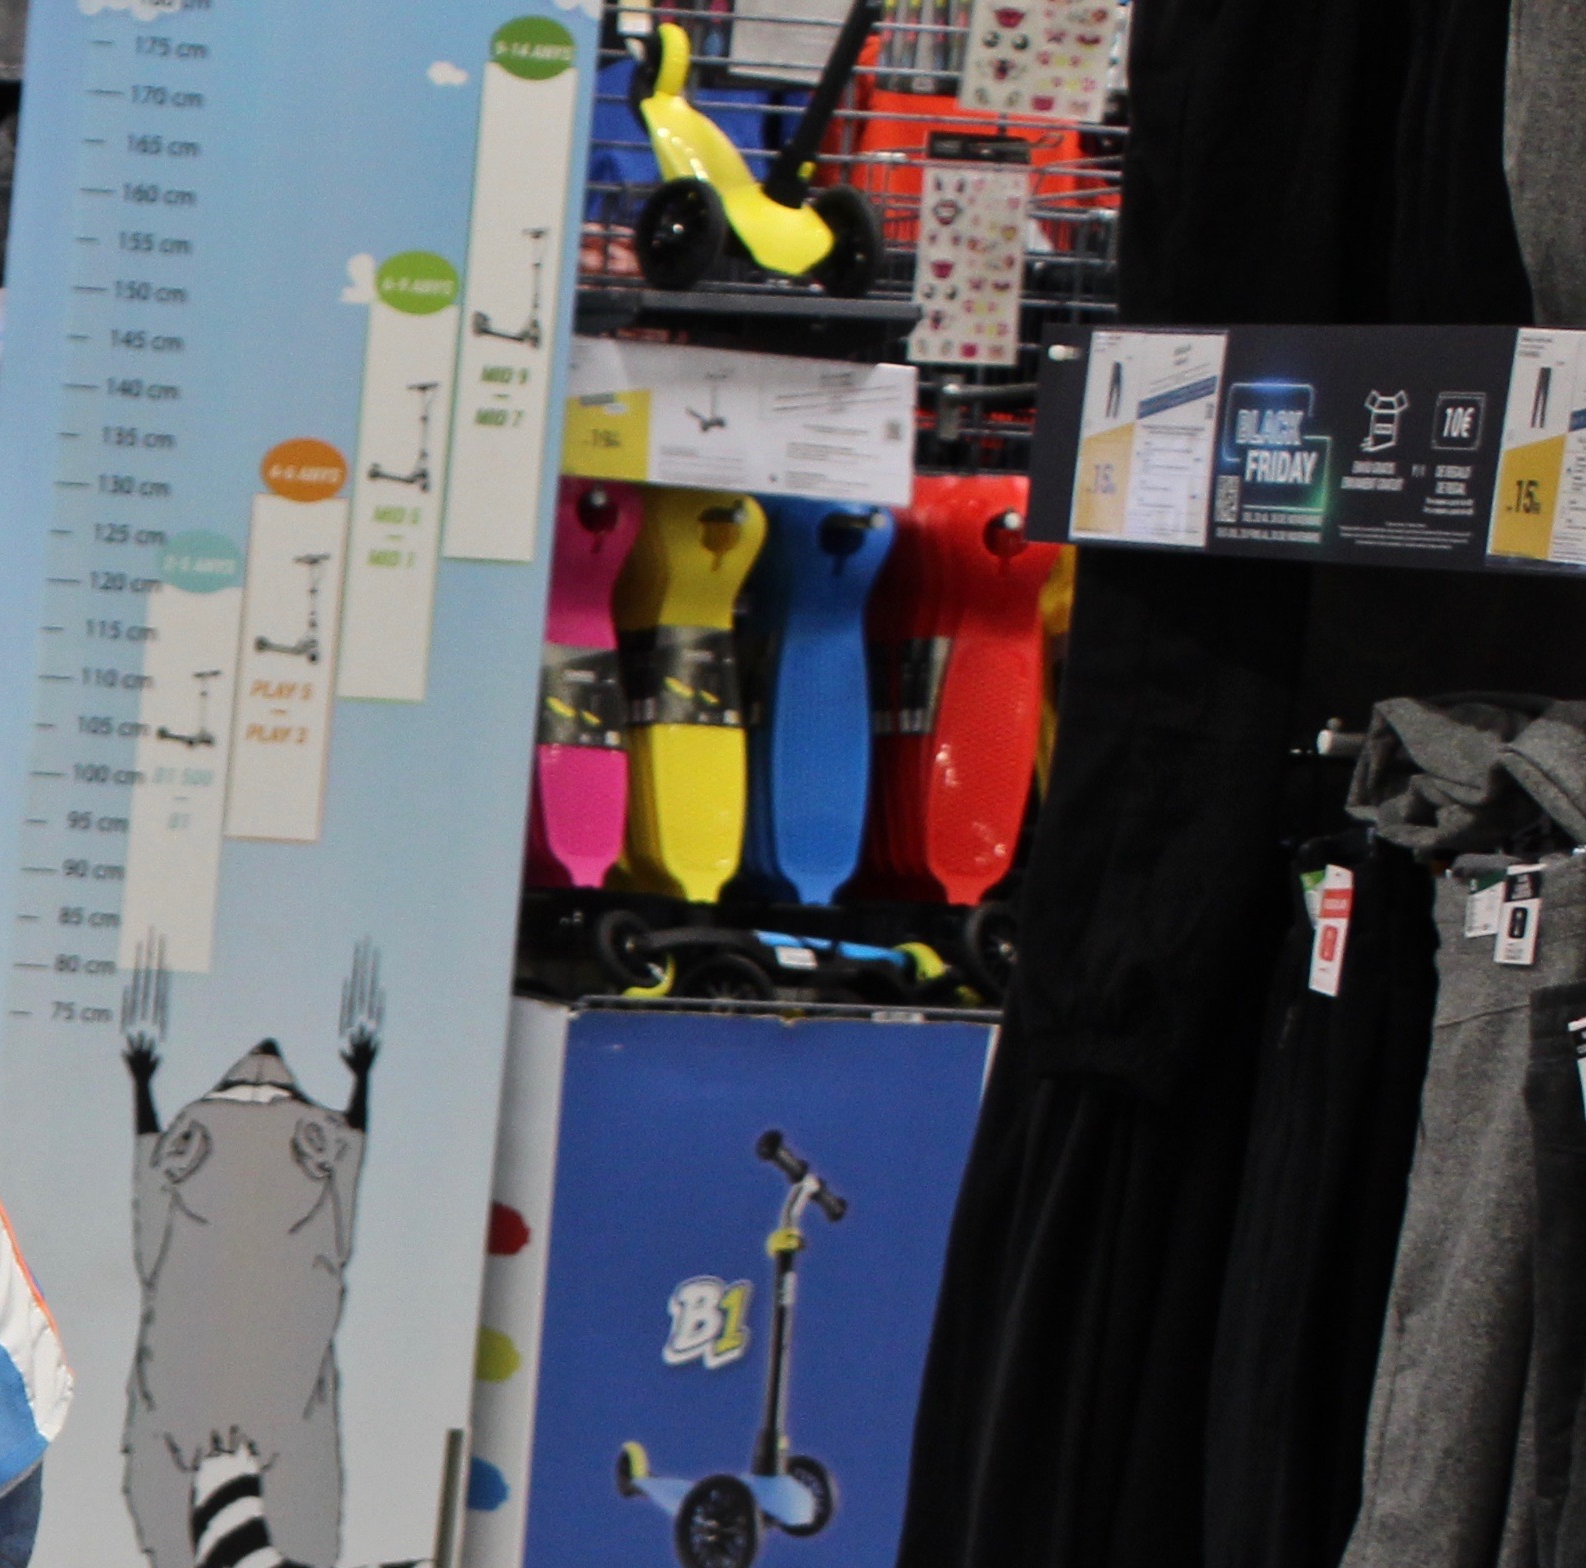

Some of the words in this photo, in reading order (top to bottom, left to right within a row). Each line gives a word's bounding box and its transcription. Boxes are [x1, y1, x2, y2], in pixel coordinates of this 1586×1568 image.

[177, 43, 208, 58] cm
[172, 92, 203, 107] cm
[167, 141, 199, 156] cm
[164, 190, 196, 205] cm
[159, 239, 192, 254] cm
[155, 287, 187, 302] cm
[151, 336, 184, 351] cm
[147, 384, 180, 399] cm
[1235, 408, 1304, 446] BLACK
[1442, 406, 1476, 438] 10€
[144, 433, 176, 448] cm
[1244, 449, 1319, 485] FRIDAY
[139, 481, 171, 496] cm
[135, 530, 167, 545] cm
[130, 578, 162, 593] cm
[127, 626, 158, 641] cm
[122, 674, 153, 689] cm
[250, 680, 298, 699] PLAY
[117, 722, 149, 737] cm
[245, 723, 293, 743] PLAY
[113, 770, 145, 785] cm
[97, 817, 129, 832] cm
[93, 865, 125, 880] cm
[88, 912, 120, 927] cm
[84, 960, 116, 975] cm
[81, 1007, 113, 1022] cm
[662, 1275, 754, 1369] B1
